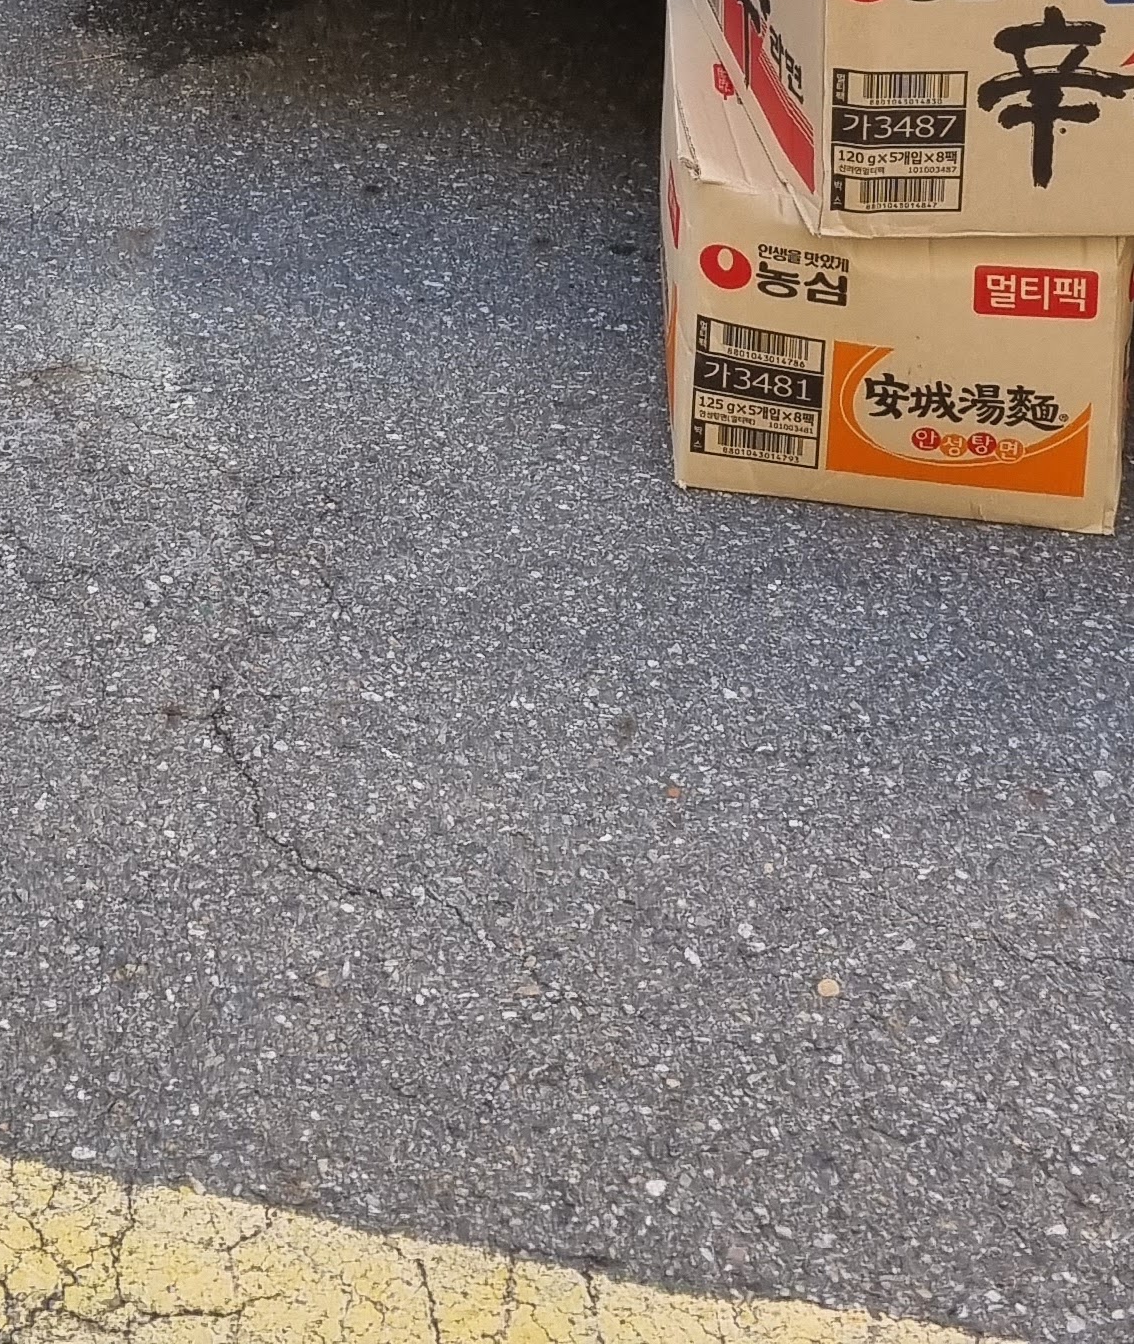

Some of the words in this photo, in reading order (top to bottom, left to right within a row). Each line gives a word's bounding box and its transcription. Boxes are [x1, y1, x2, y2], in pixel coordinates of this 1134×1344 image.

[977, 5, 1134, 189] 辛
[842, 114, 958, 141] 가3487
[838, 150, 865, 164] 120
[758, 244, 802, 264] 인생을
[804, 252, 850, 273] 맛있게
[756, 260, 848, 307] 농심
[986, 274, 1087, 312] 멀티팩
[703, 362, 811, 401] 가3481
[699, 395, 724, 410] 125
[914, 428, 1019, 461] 안성탕면
